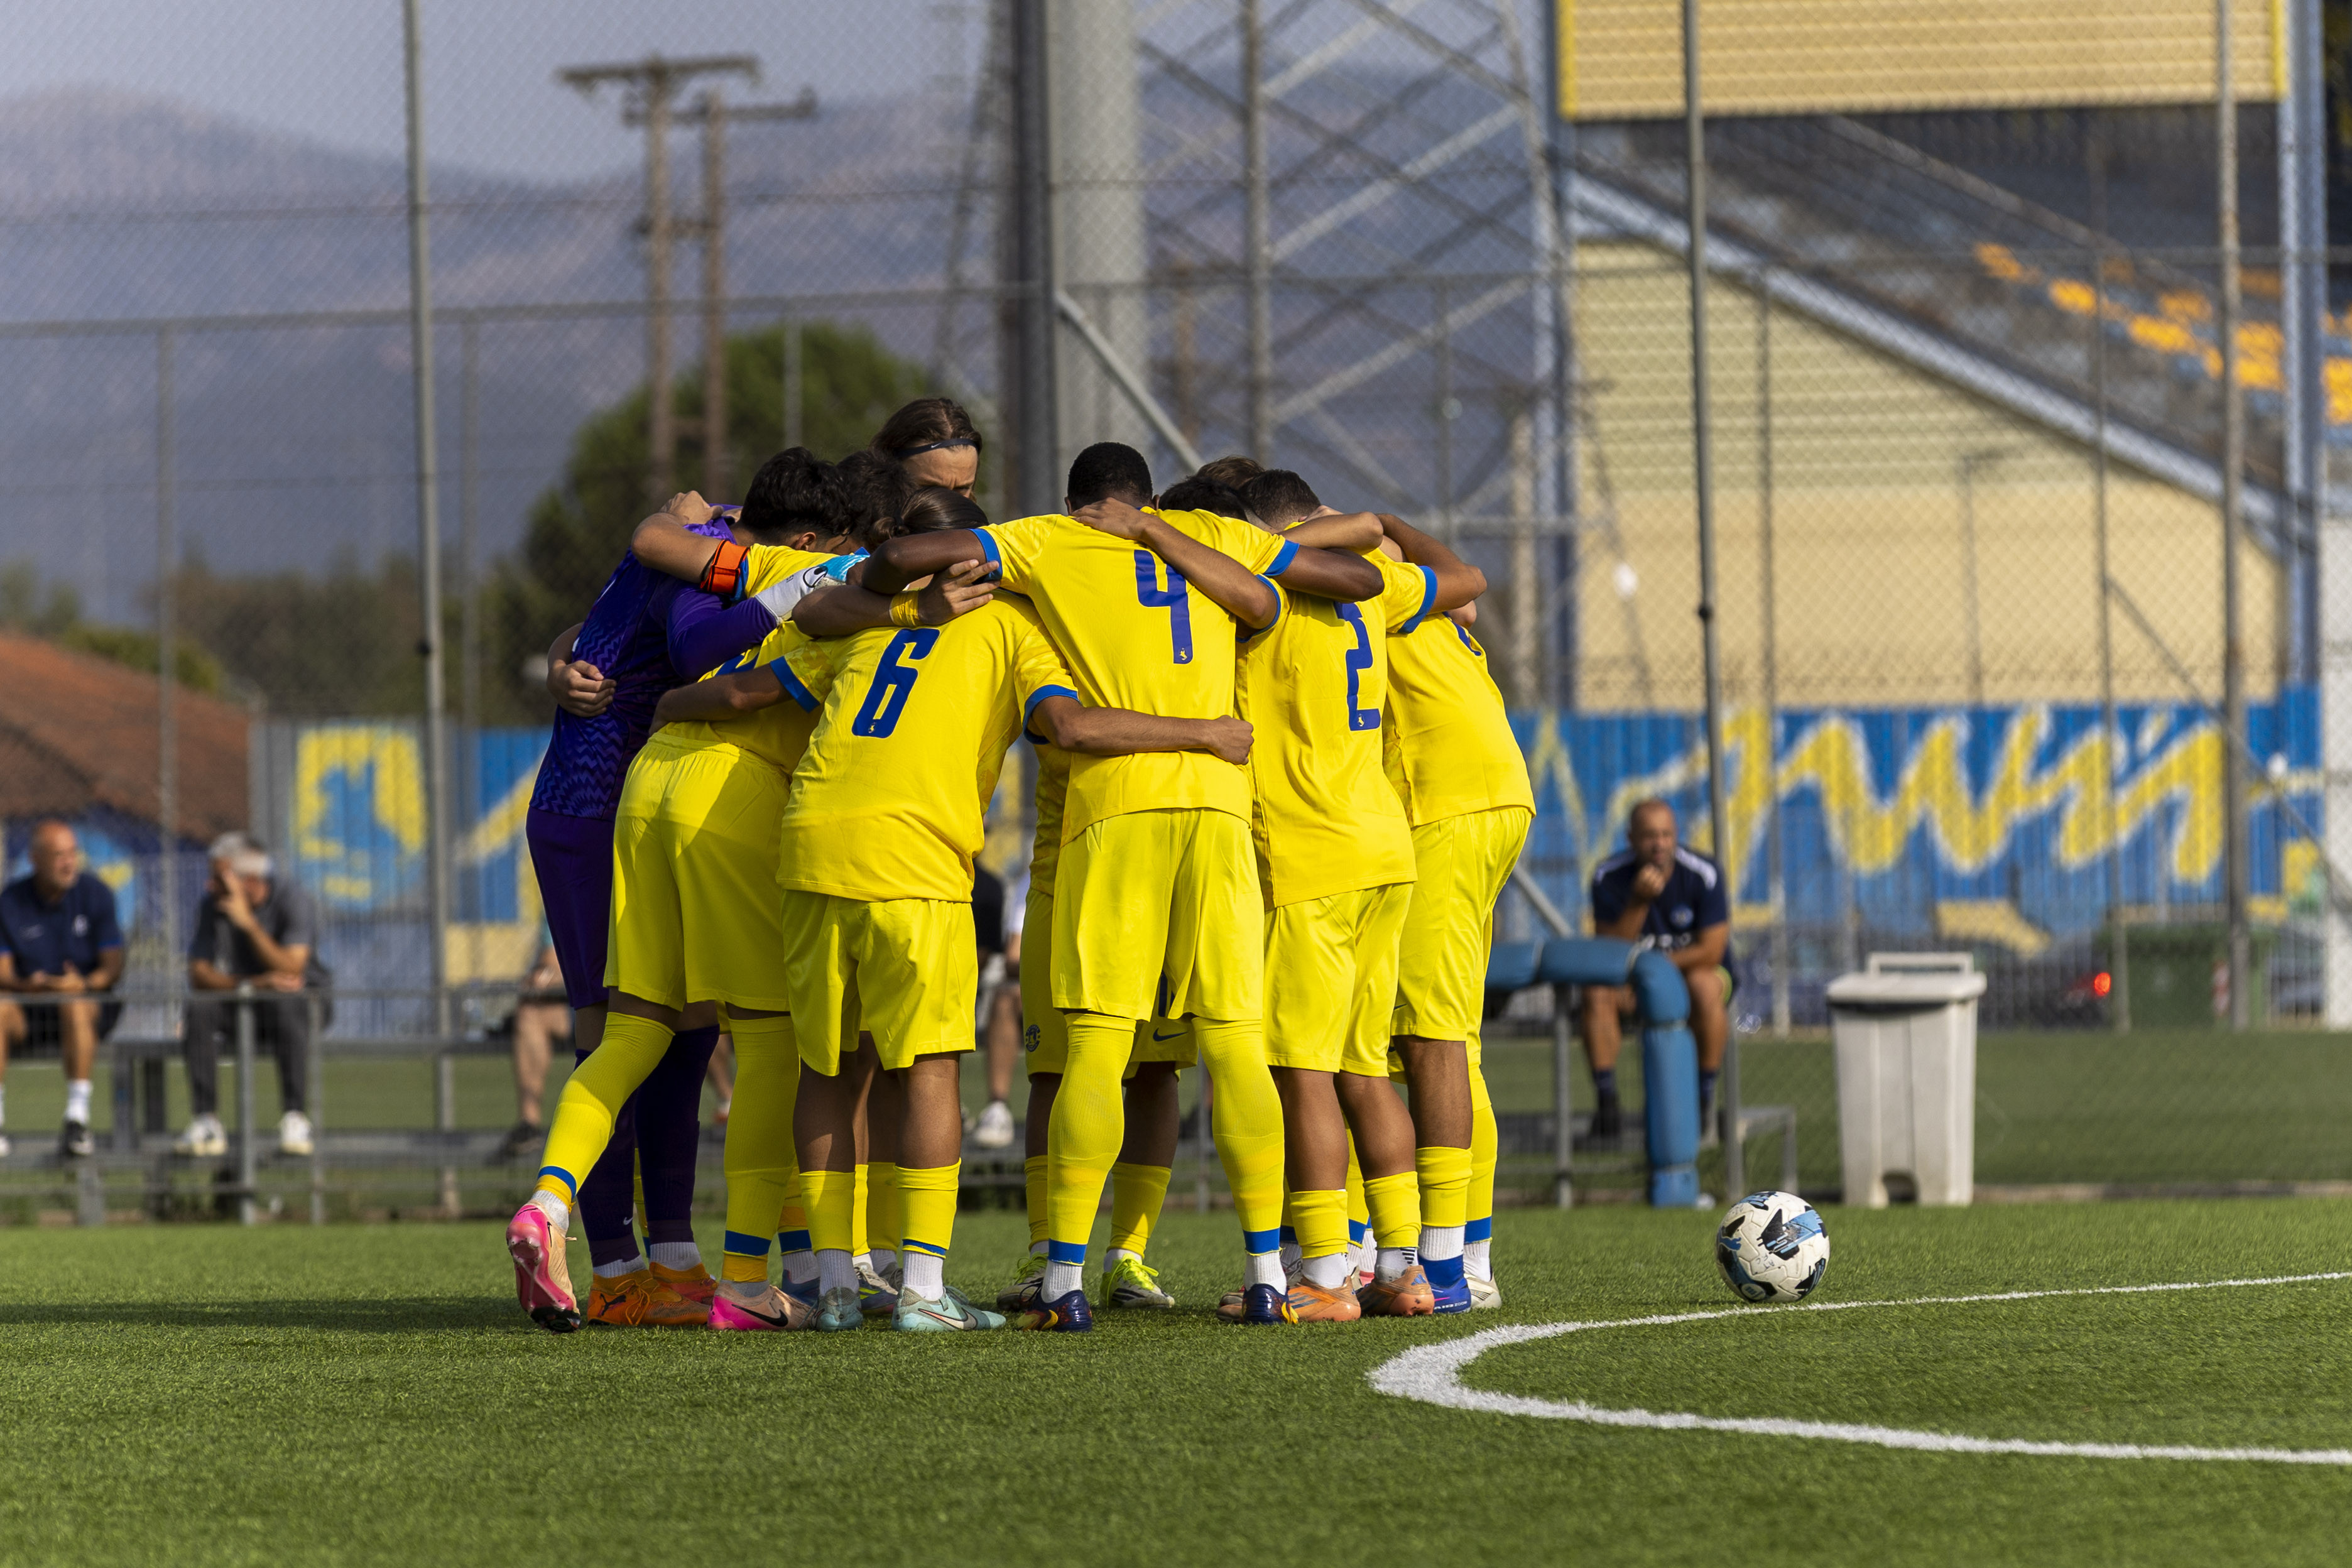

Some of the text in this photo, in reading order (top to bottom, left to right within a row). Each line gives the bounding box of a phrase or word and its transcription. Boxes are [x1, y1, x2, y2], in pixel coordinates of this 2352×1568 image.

[1135, 550, 1192, 664] 4
[851, 629, 940, 738] 6
[1333, 601, 1381, 731] 2
